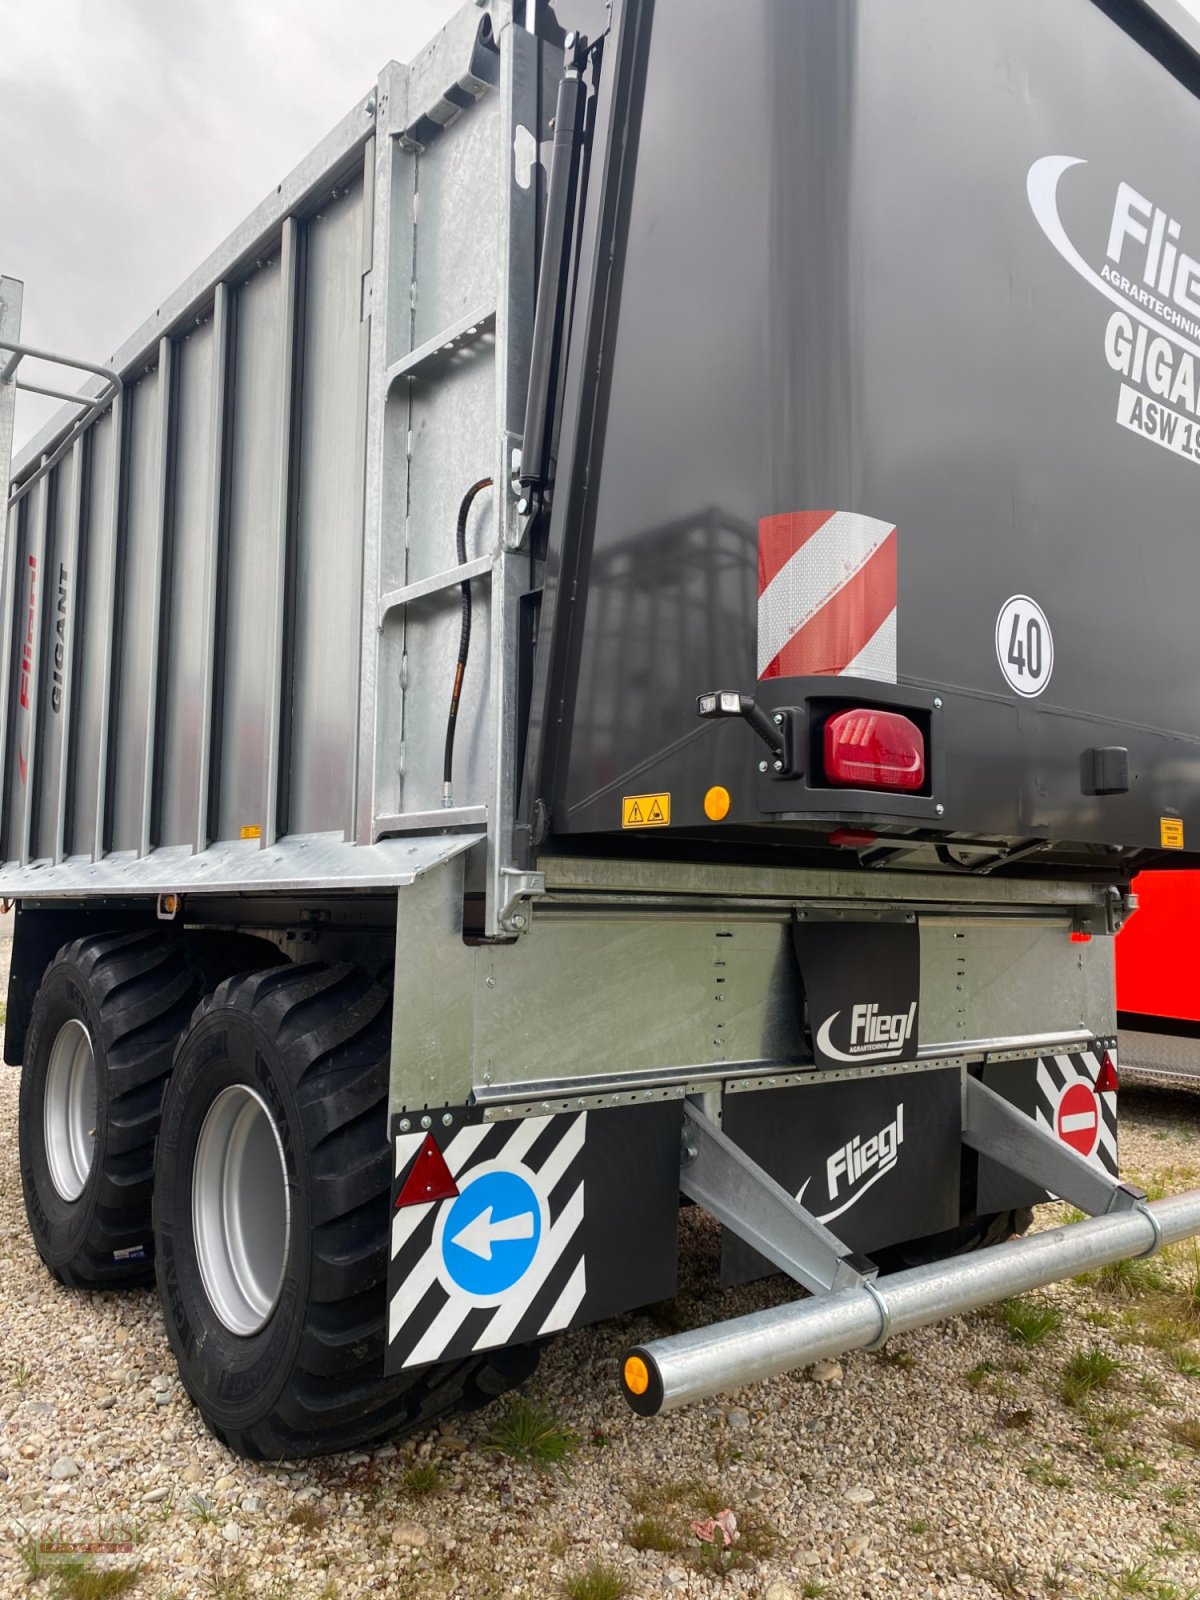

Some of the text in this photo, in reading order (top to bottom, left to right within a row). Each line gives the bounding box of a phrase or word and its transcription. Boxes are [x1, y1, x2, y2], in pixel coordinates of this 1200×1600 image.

[1104, 311, 1200, 416] GIGA
[1129, 396, 1179, 445] ASW
[51, 562, 69, 714] GIGANT
[1007, 613, 1042, 679] 40
[850, 1002, 917, 1048] Fliegl
[826, 1103, 904, 1200] Fliegl
